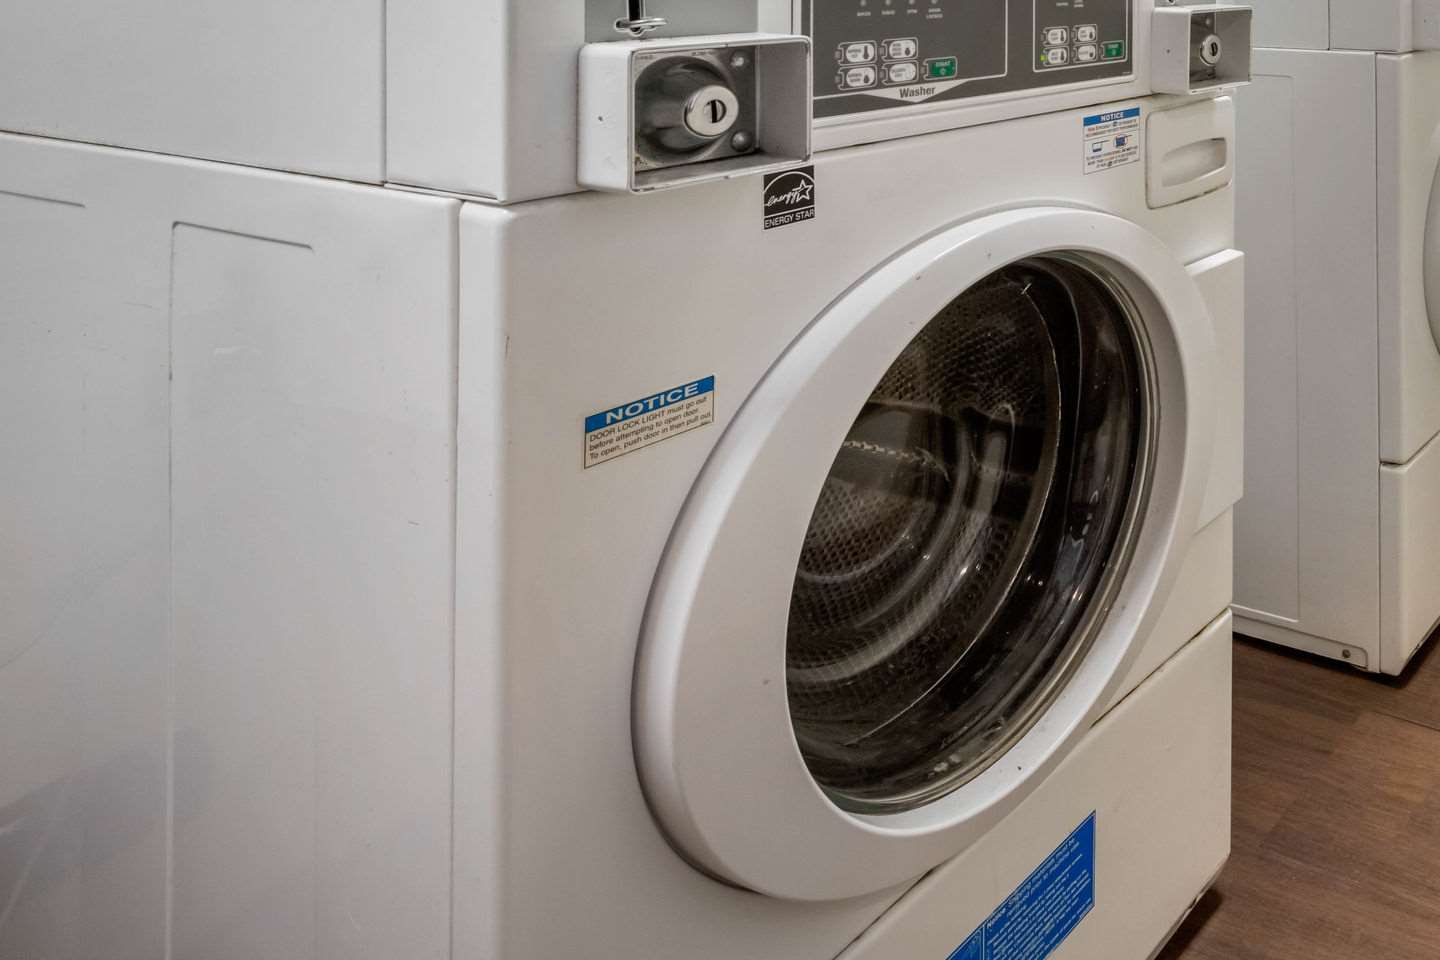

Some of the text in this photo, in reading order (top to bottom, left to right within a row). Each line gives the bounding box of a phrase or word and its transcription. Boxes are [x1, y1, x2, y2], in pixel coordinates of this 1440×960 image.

[899, 86, 936, 99] Washer
[1100, 111, 1124, 122] NOTICE
[764, 208, 815, 229] ENERGY STAR
[606, 382, 699, 424] NOTICE
[589, 438, 614, 452] before
[615, 424, 655, 442] attempting
[664, 414, 682, 427] open
[589, 451, 599, 459] To
[623, 436, 642, 449] push
[643, 429, 660, 440] door
[669, 420, 686, 431] then
[686, 415, 699, 426] pull
[590, 427, 616, 442] DOOR
[617, 419, 640, 433] LOCK
[641, 409, 666, 424] LIGHT
[667, 404, 684, 416] must
